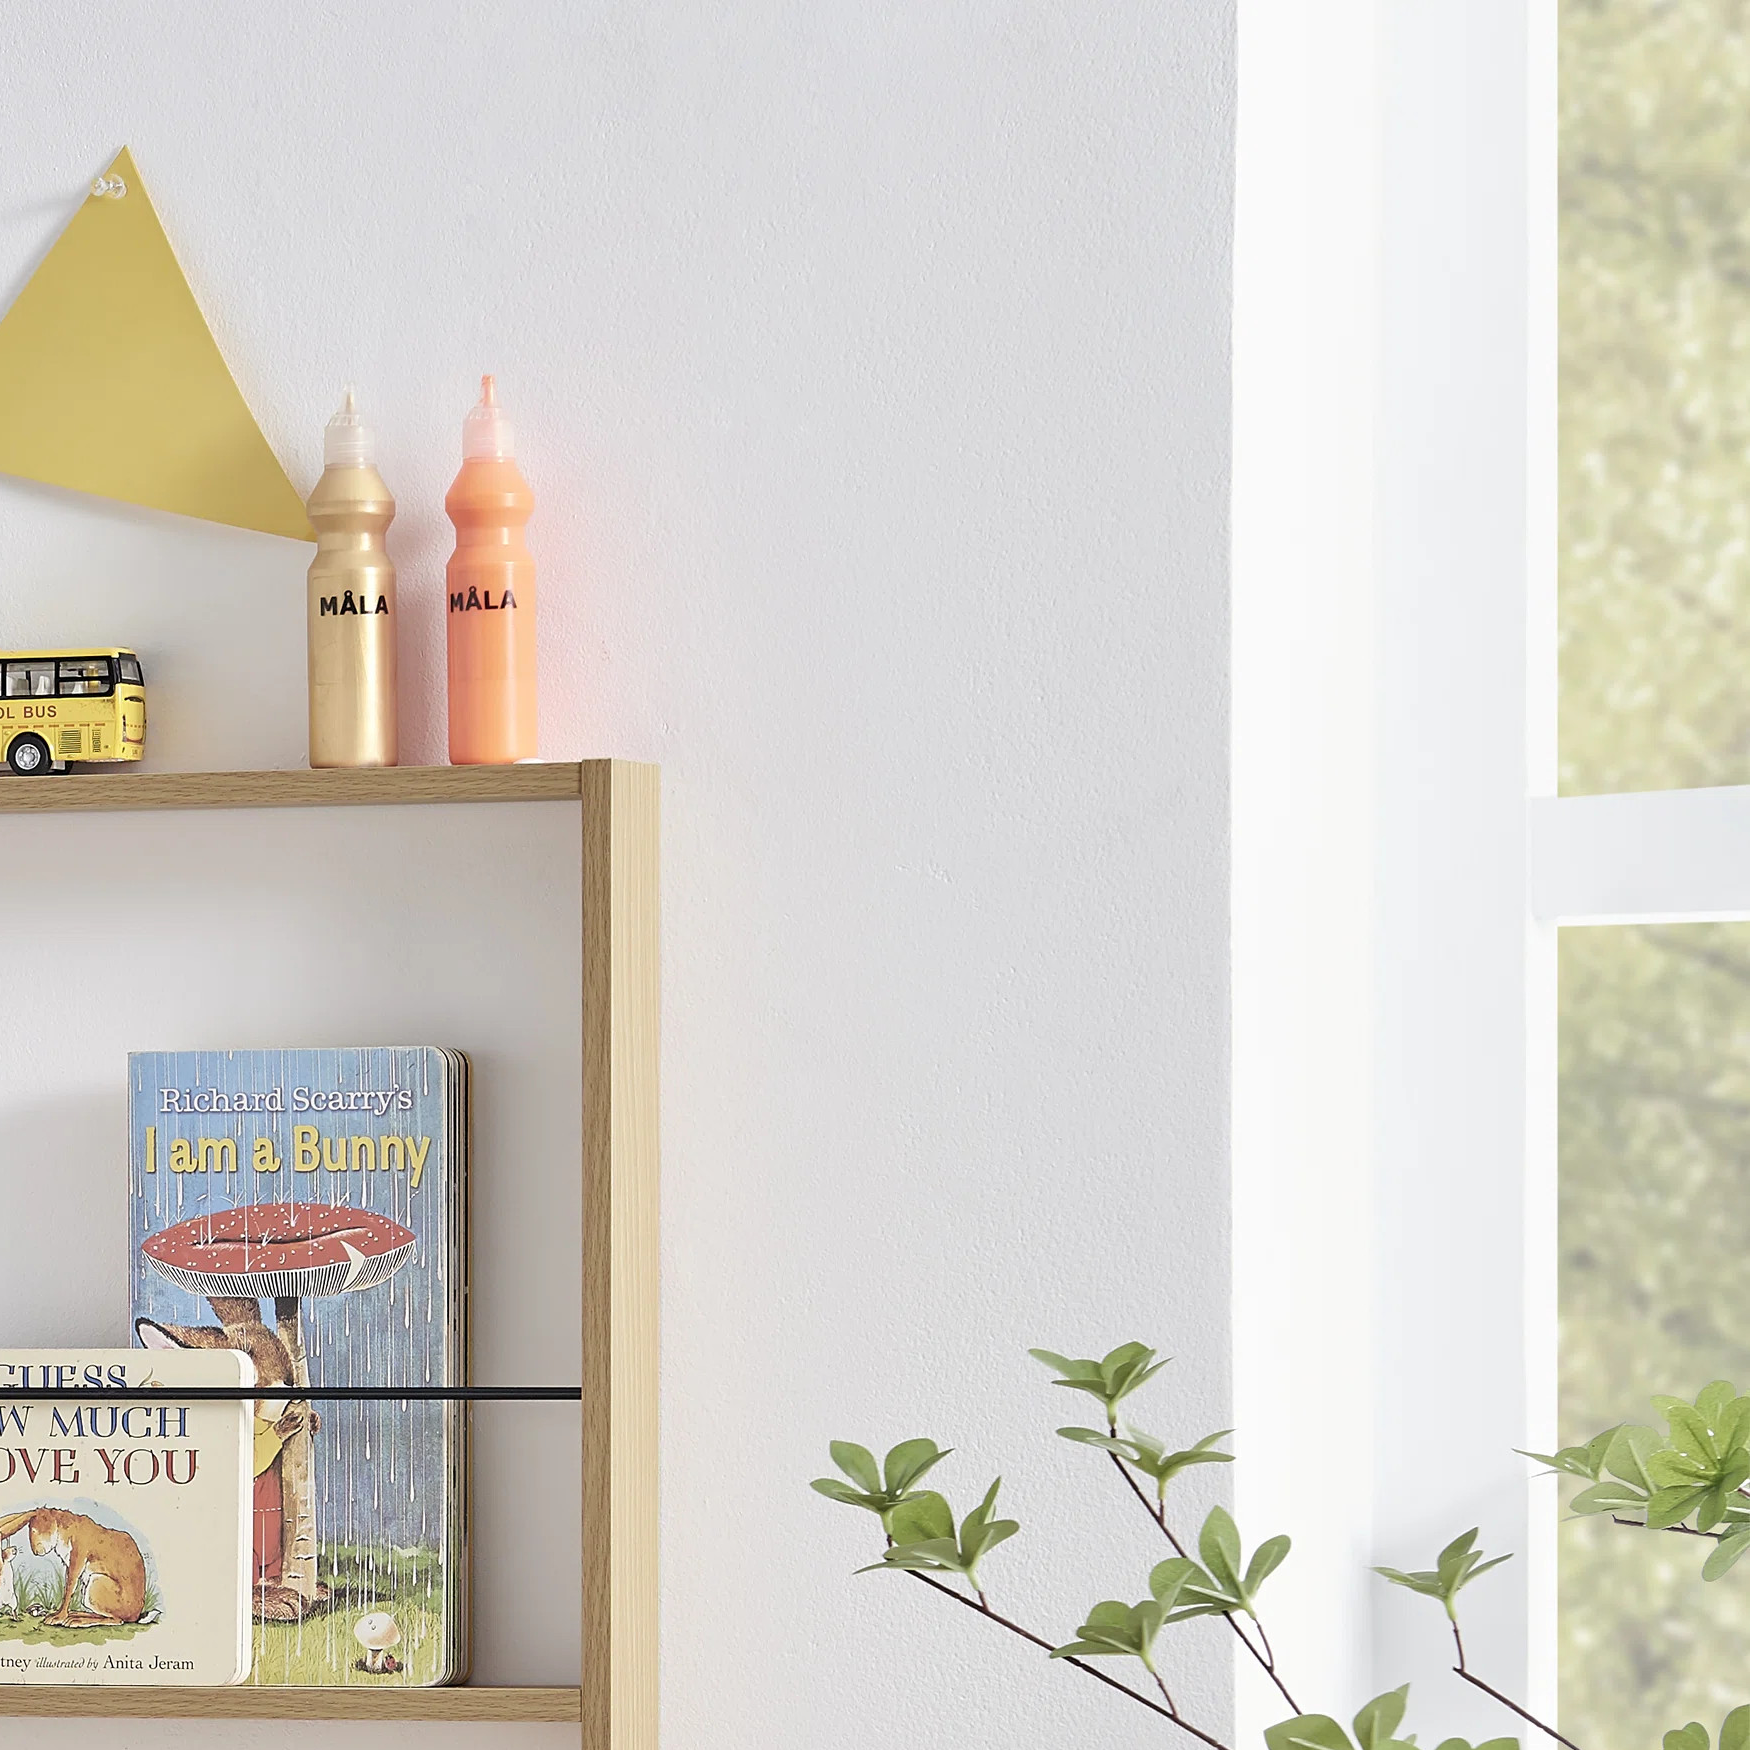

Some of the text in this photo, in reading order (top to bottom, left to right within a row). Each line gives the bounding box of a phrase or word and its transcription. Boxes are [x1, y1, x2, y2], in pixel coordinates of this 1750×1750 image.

[320, 590, 389, 616] MÅLA
[450, 586, 517, 613] MÅLA
[23, 705, 57, 719] BUS
[159, 1084, 413, 1115] Richard Scarry's
[145, 1125, 431, 1188] I am a Bunny
[49, 1406, 191, 1439] MUCH
[94, 1449, 200, 1485] YOU
[35, 1656, 86, 1669] illustrated
[86, 1658, 99, 1672] by
[103, 1654, 144, 1670] Anita
[149, 1655, 195, 1671] Jeram
